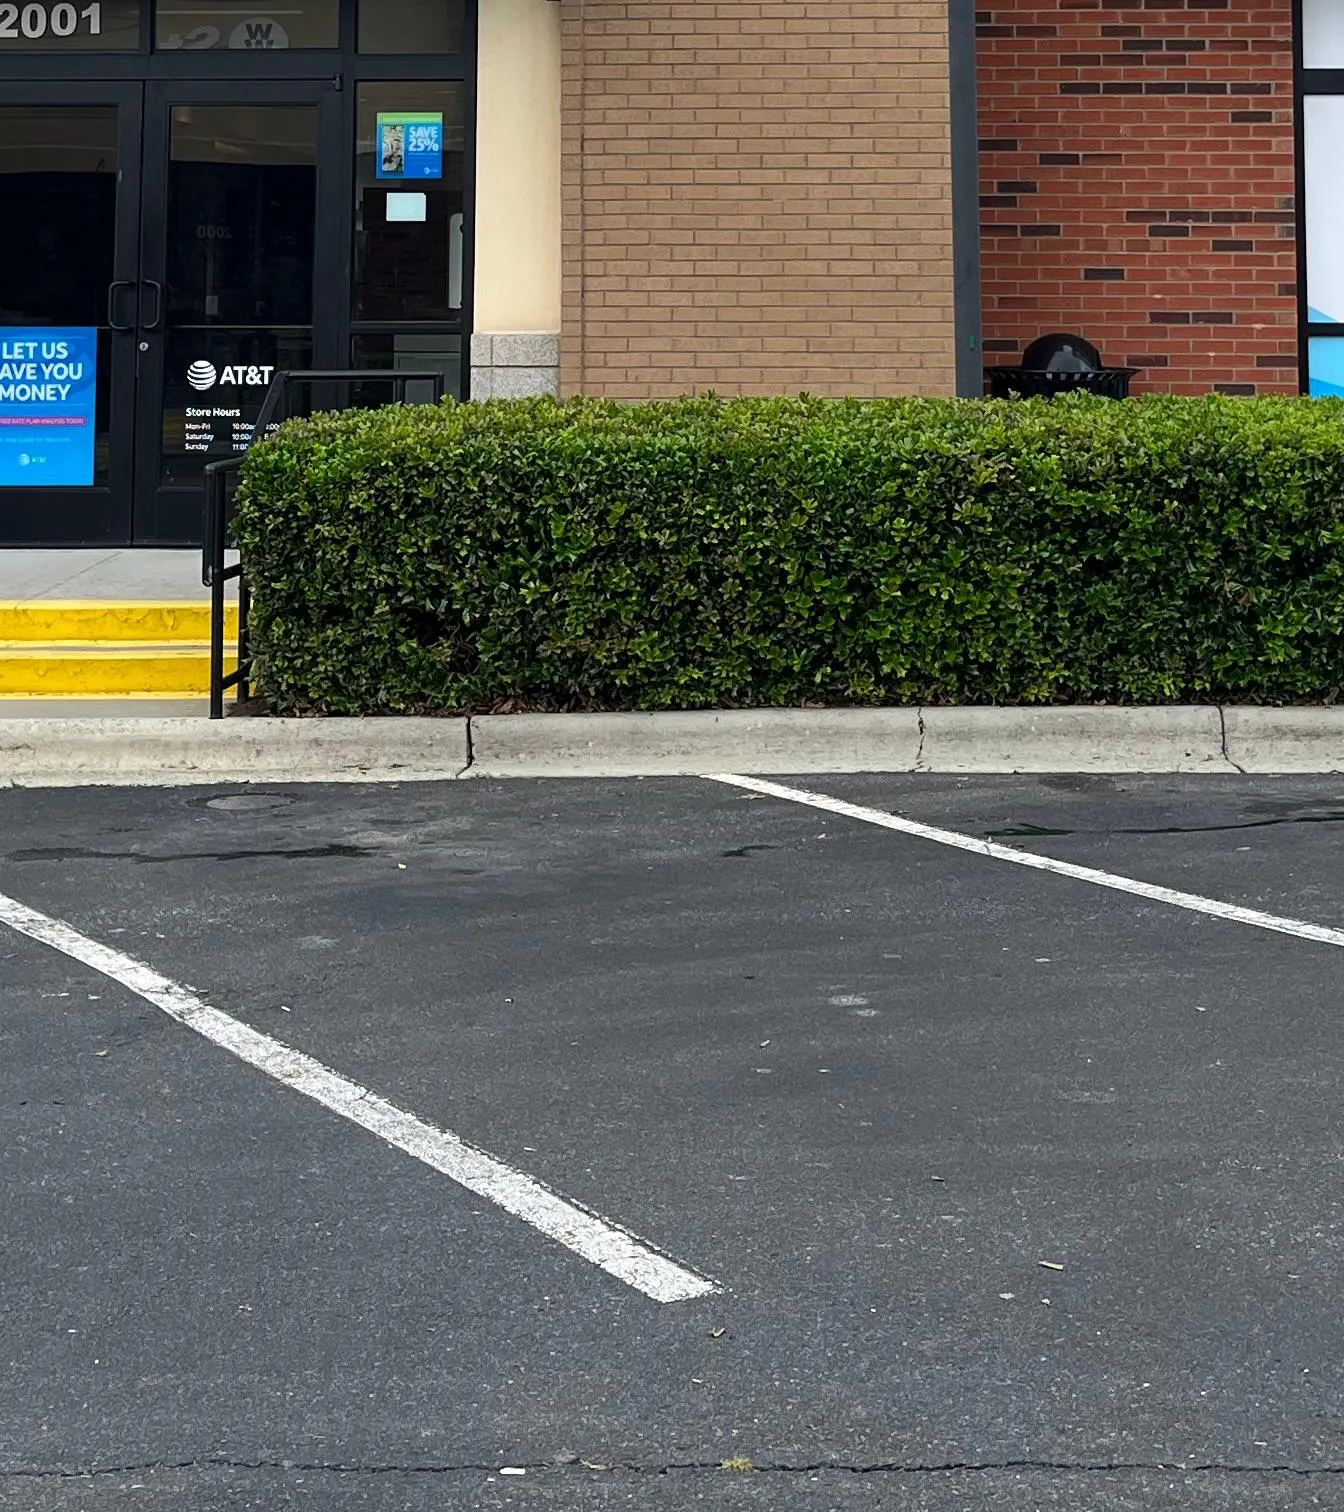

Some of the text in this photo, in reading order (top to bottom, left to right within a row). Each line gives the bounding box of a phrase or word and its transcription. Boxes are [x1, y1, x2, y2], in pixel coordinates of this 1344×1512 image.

[409, 126, 438, 138] SAVE
[408, 138, 439, 152] 25%
[1, 342, 69, 360] LET US
[41, 362, 83, 381] YOU
[219, 365, 274, 385] AT&T
[185, 407, 241, 417] Store Hours
[185, 433, 214, 441] Saturday
[185, 443, 209, 451] Sunday
